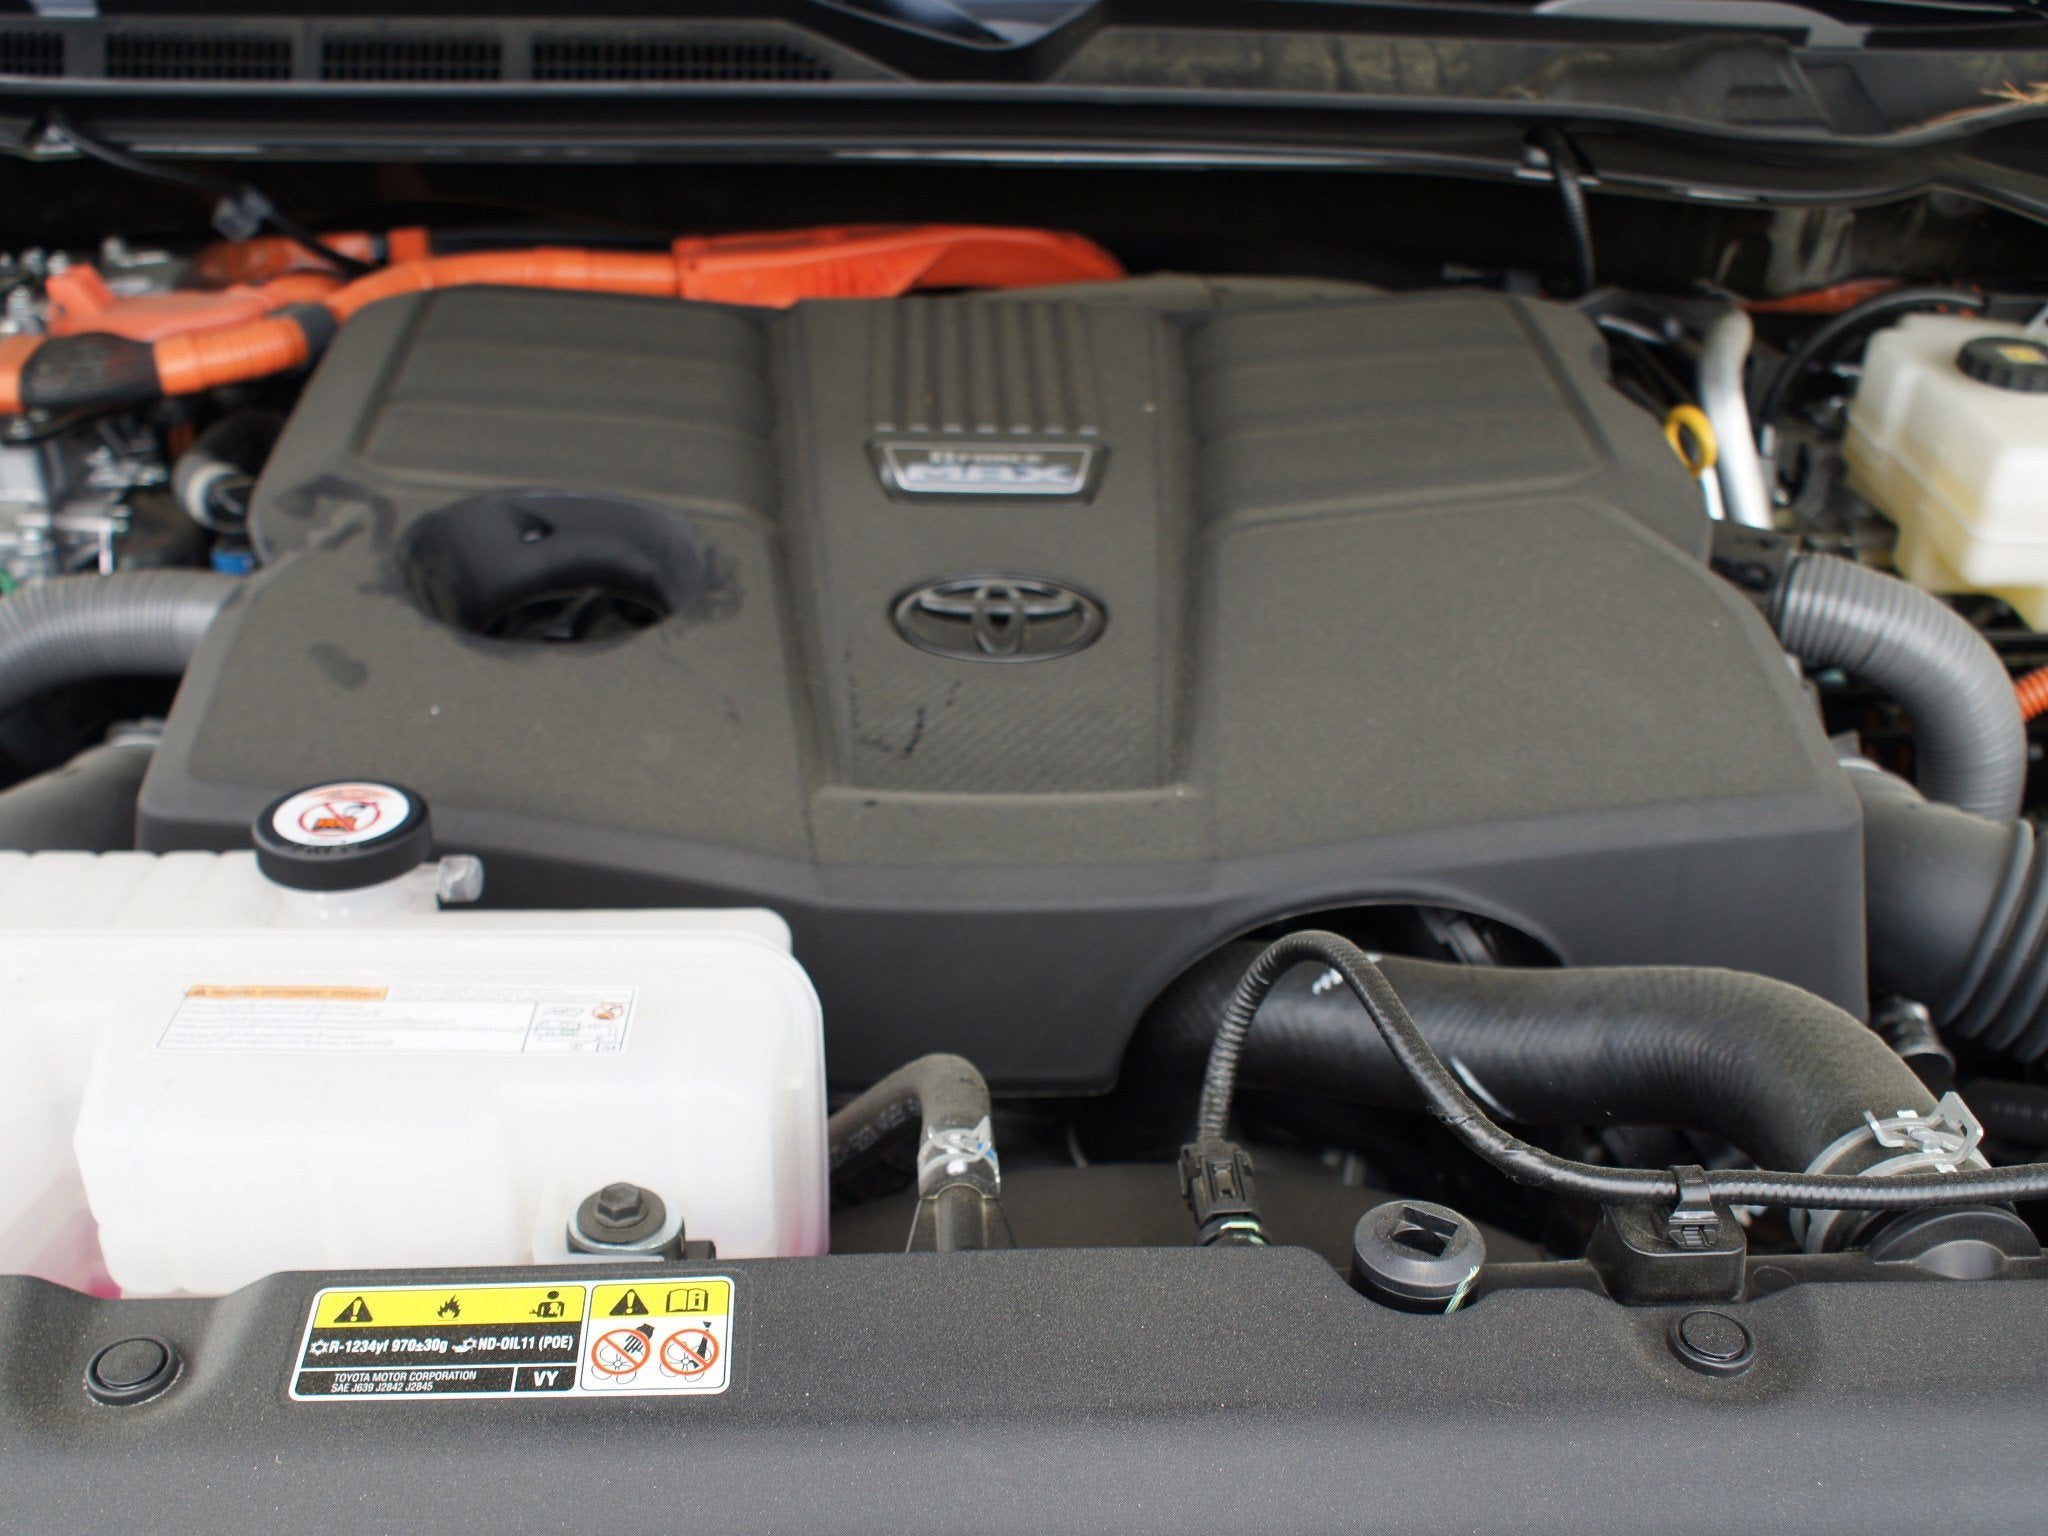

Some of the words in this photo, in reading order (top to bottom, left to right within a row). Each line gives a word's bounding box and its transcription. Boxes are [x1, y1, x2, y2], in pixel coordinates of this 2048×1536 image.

[328, 1339, 390, 1355] R-1234yf
[391, 1338, 448, 1353] 970±30g
[478, 1336, 536, 1351] ND-OIL11
[538, 1335, 574, 1351] (POE)
[334, 1372, 371, 1382] TOYOTA
[372, 1371, 408, 1382] MOTOR
[408, 1370, 477, 1381] CORPORATION
[533, 1370, 560, 1387] VY
[331, 1382, 351, 1393] SAE
[351, 1382, 374, 1393] J639
[375, 1381, 403, 1392] J2842
[405, 1381, 433, 1392] J2845
